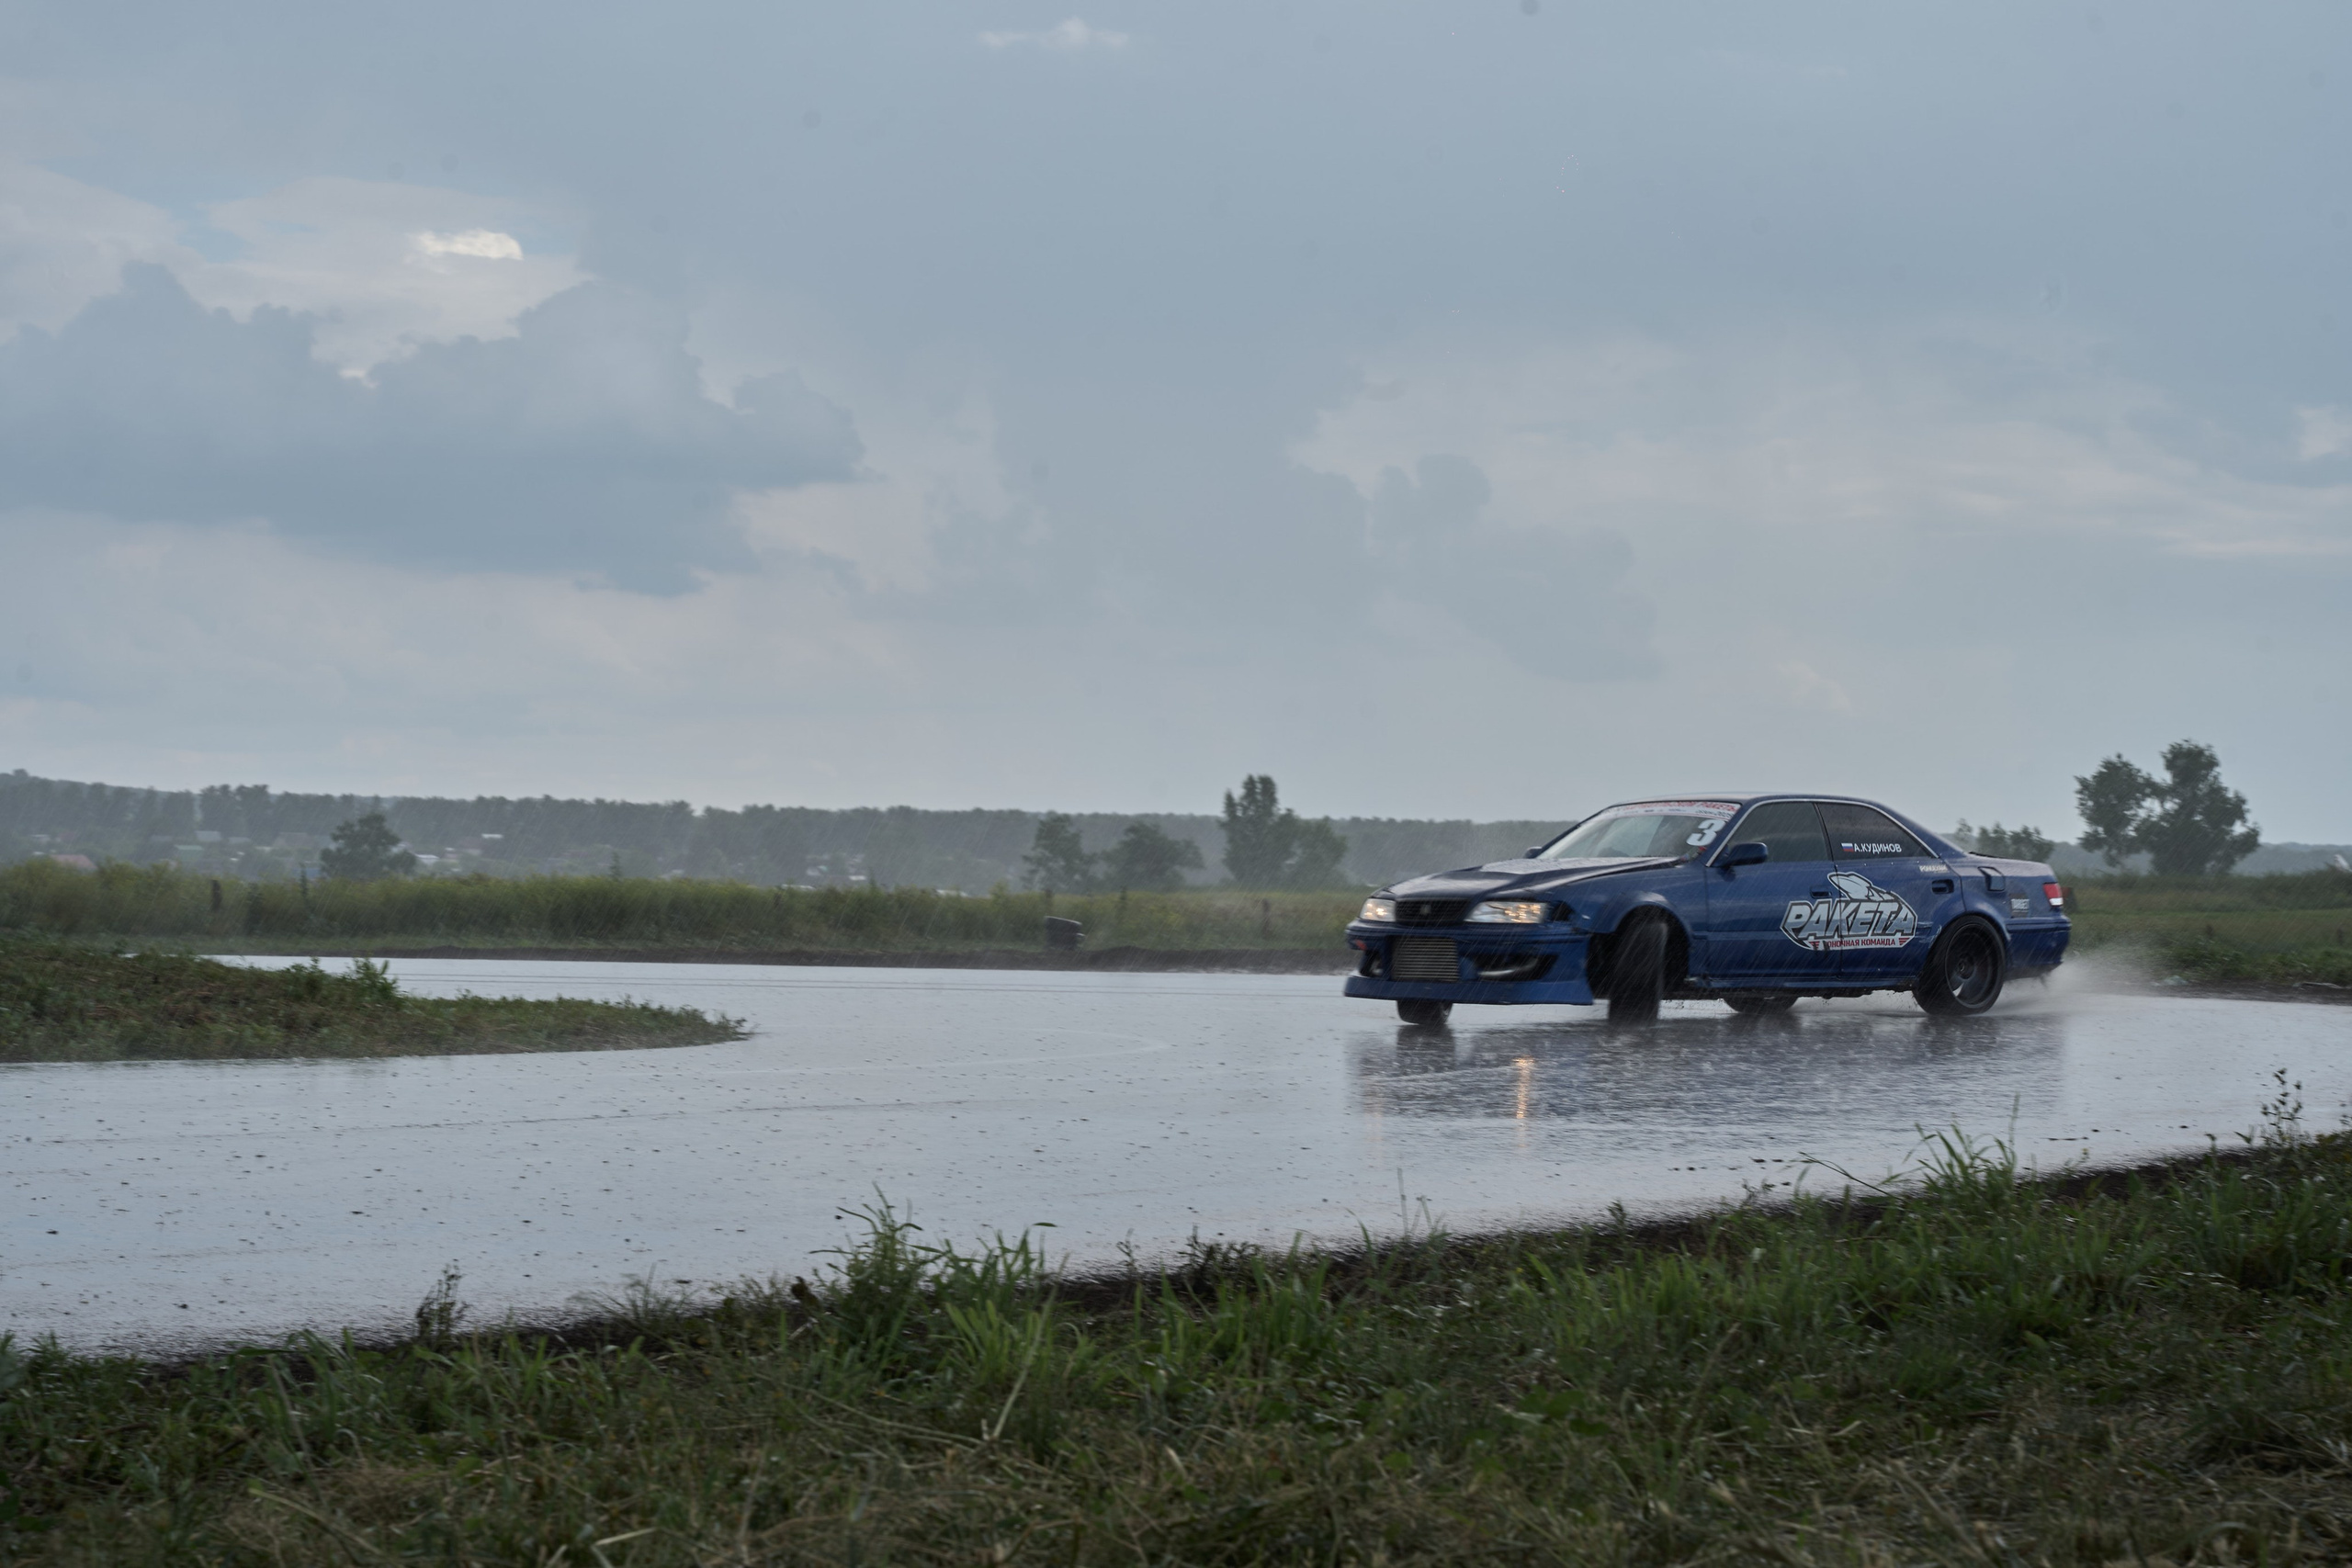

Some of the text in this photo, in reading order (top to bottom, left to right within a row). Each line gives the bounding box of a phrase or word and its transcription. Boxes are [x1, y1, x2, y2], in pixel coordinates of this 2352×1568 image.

[1686, 819, 1726, 846] 3
[1854, 842, 1902, 854] А.КУДИНОВ
[1782, 900, 1915, 938] РАКЕТА
[1824, 938, 1895, 948] ОНОЧНАЯ КОМАНДА
